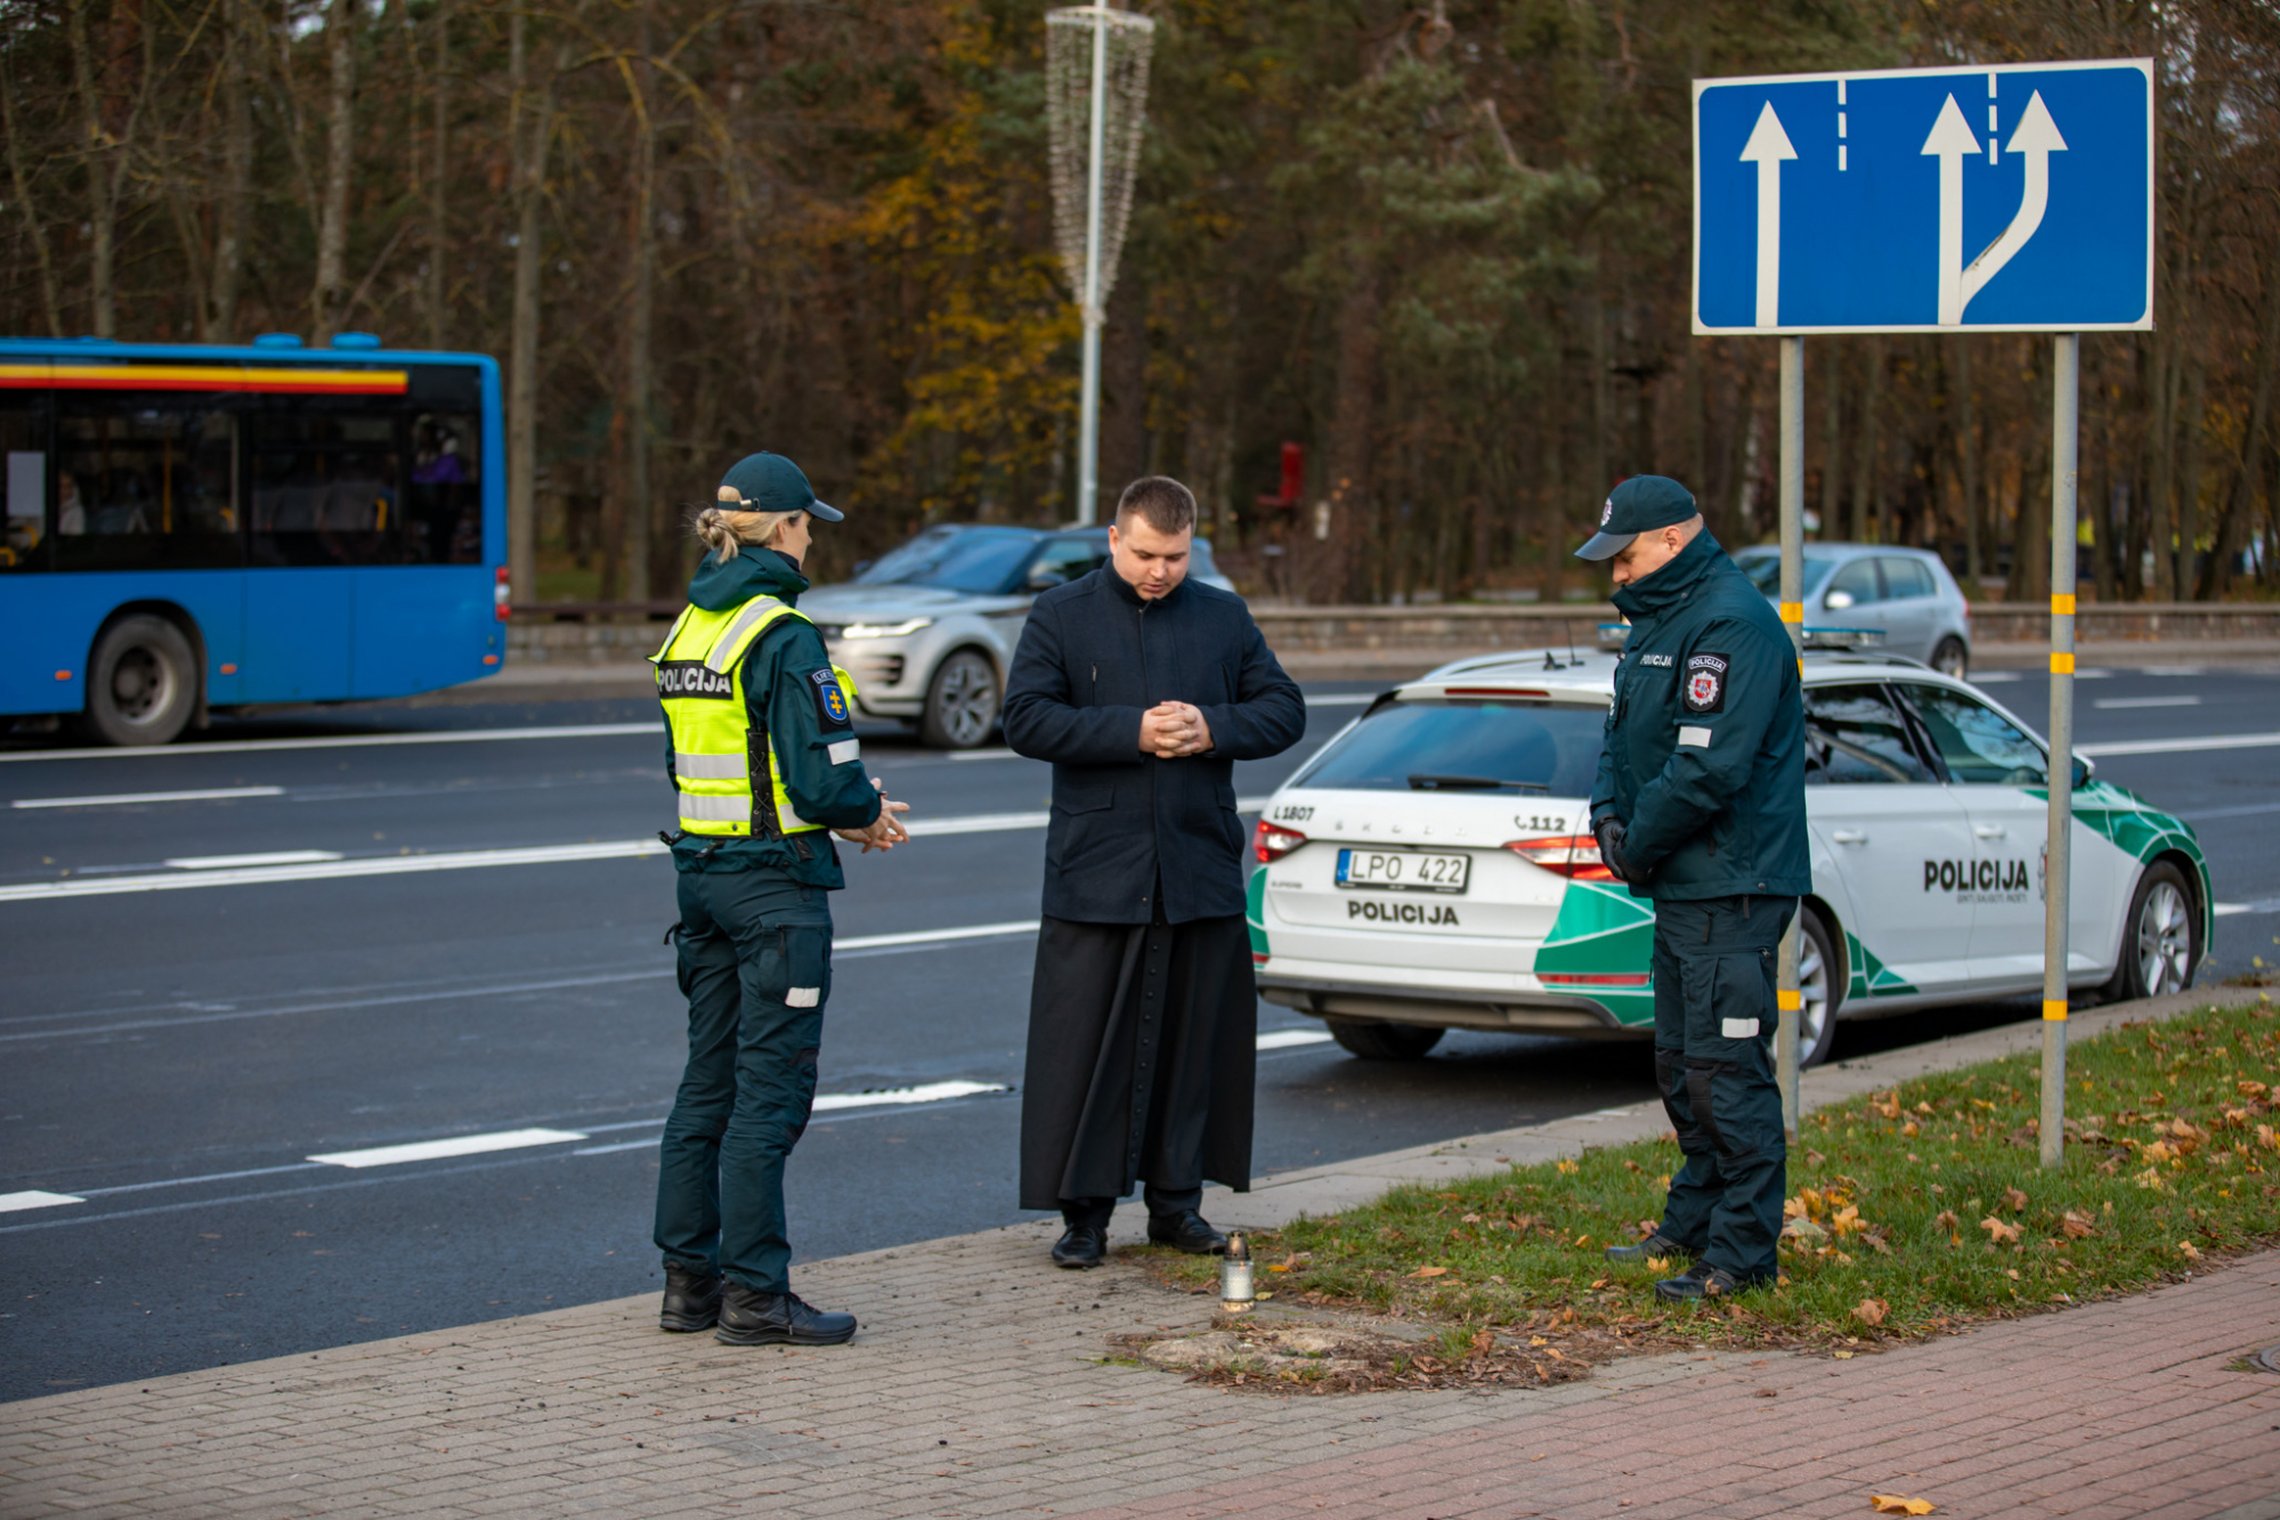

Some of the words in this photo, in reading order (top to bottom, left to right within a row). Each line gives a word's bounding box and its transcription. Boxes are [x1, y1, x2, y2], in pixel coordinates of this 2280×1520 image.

[1690, 657, 1723, 669] POLICIJA
[659, 668, 732, 693] POLICIJA
[1529, 816, 1566, 832] 112
[1351, 854, 1402, 880] LPO
[1417, 857, 1463, 884] 422
[1924, 859, 2029, 892] POLICIJA
[1347, 900, 1460, 926] POLICIJA
